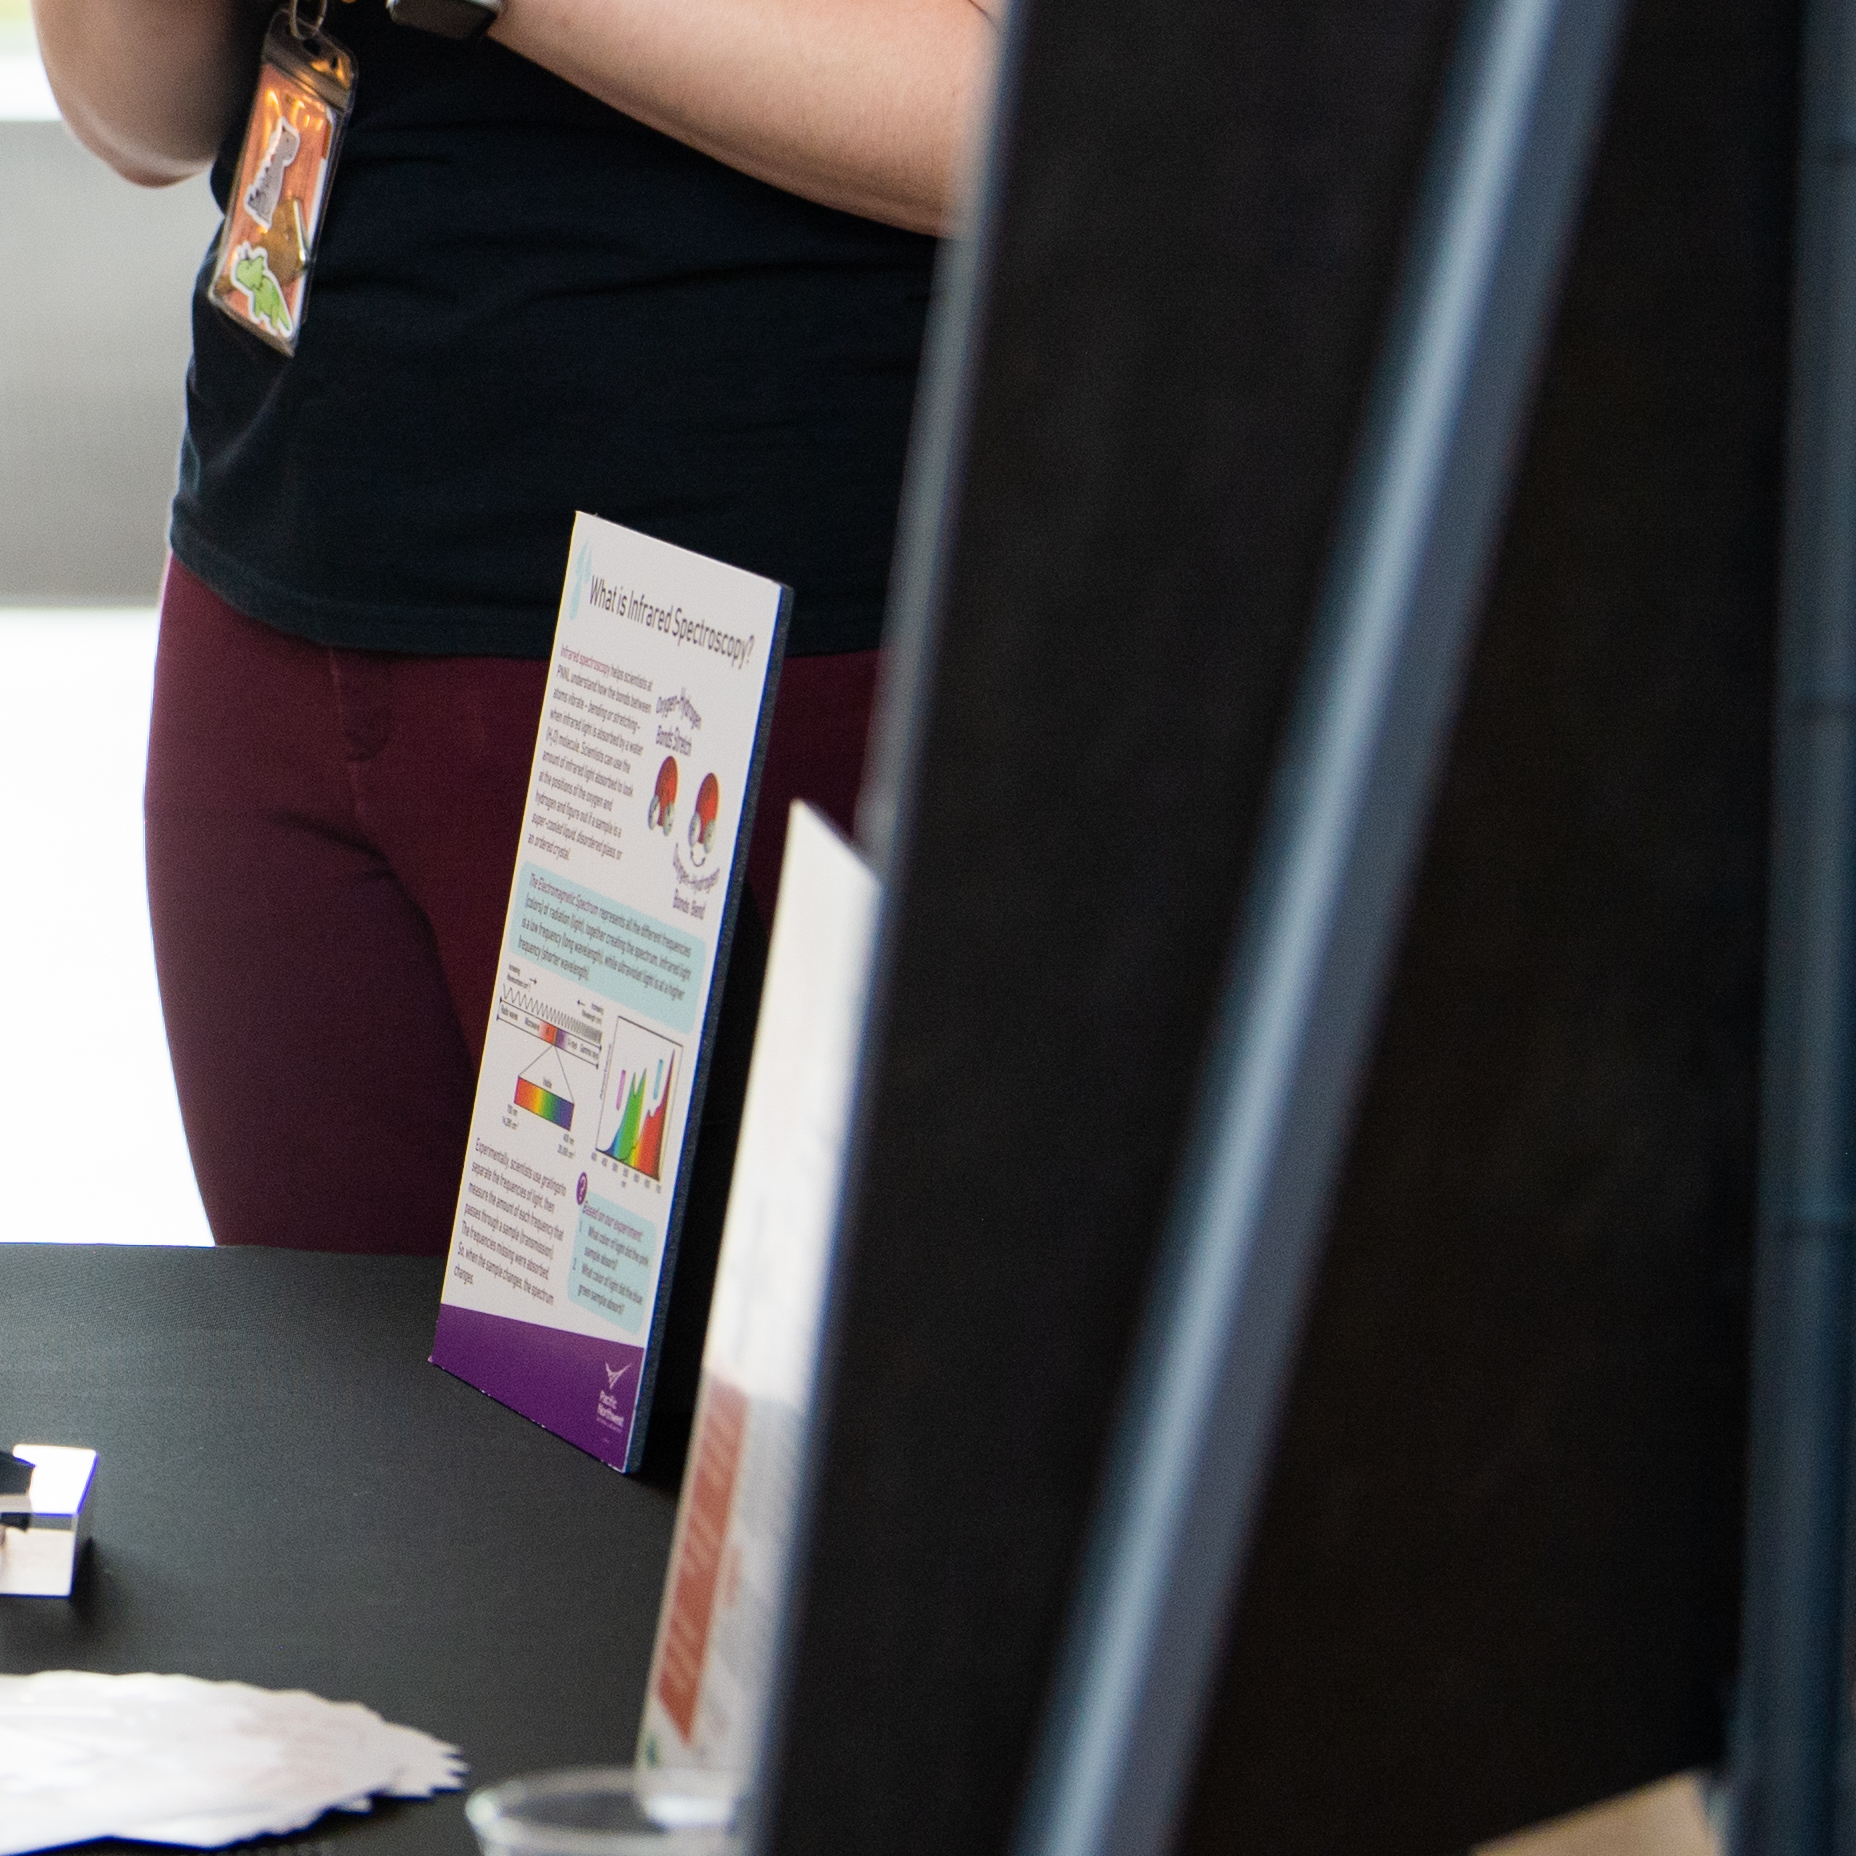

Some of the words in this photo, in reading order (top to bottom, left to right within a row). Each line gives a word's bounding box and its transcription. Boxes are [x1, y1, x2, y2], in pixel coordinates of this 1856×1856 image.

[589, 575, 617, 613] What
[627, 590, 673, 634] Infrared
[672, 607, 755, 669] Spectroscopy?
[556, 664, 570, 682] PNNL
[570, 674, 598, 693] understand
[597, 683, 608, 696] how
[607, 686, 616, 700] the
[615, 690, 631, 706] bonds
[630, 695, 652, 713] between
[560, 644, 580, 663] Infrared
[578, 654, 611, 678] spectroscopy
[610, 664, 624, 681] helps
[623, 672, 648, 690] scientists
[552, 688, 569, 703] atoms
[568, 692, 584, 710] vibrate
[587, 702, 608, 722] bending
[550, 709, 563, 722] when
[562, 713, 582, 731] infrared
[581, 719, 593, 737] light
[596, 728, 620, 747] absorbed
[629, 743, 644, 756] water
[542, 750, 560, 766] amount
[565, 759, 585, 777] infrared
[583, 765, 595, 783] light
[594, 772, 618, 791] absorbed
[622, 785, 634, 797] look
[580, 741, 605, 763] Scientists
[604, 754, 614, 766] can
[613, 759, 623, 770] use
[622, 759, 631, 774] the
[535, 790, 557, 811] hydrogen
[556, 801, 567, 814] and
[566, 802, 580, 820] figure
[579, 811, 589, 823] out
[595, 818, 613, 835] sample
[543, 771, 552, 786] the
[551, 777, 573, 795] positions
[578, 786, 586, 800] the
[586, 792, 604, 809] oxygen
[603, 799, 613, 812] and
[529, 872, 539, 889] The
[537, 877, 576, 906] Electromagnetic
[575, 893, 599, 915] Spectrum
[471, 1161, 492, 1181] separate
[492, 1170, 500, 1185] the
[499, 1173, 527, 1199] frequencies
[543, 1197, 555, 1213] then
[509, 1159, 533, 1179] scientists
[532, 1171, 542, 1184] use
[464, 1203, 481, 1220] passes
[481, 1209, 499, 1232] through
[502, 1223, 520, 1241] sample
[468, 1182, 489, 1201] measure
[488, 1191, 496, 1206] the
[495, 1197, 514, 1215] amount
[519, 1209, 531, 1223] each
[530, 1212, 555, 1239] frequency
[554, 1225, 564, 1242] that
[462, 1220, 470, 1237] The
[470, 1225, 497, 1251] frequencies
[496, 1243, 515, 1265] missing
[514, 1254, 527, 1268] were
[465, 1249, 478, 1263] when
[478, 1253, 486, 1268] the
[485, 1260, 503, 1278] sample
[523, 1279, 532, 1294] the
[531, 1285, 554, 1305] spectrum
[598, 1403, 624, 1427] Northwest
[600, 1390, 617, 1409] Pacific
